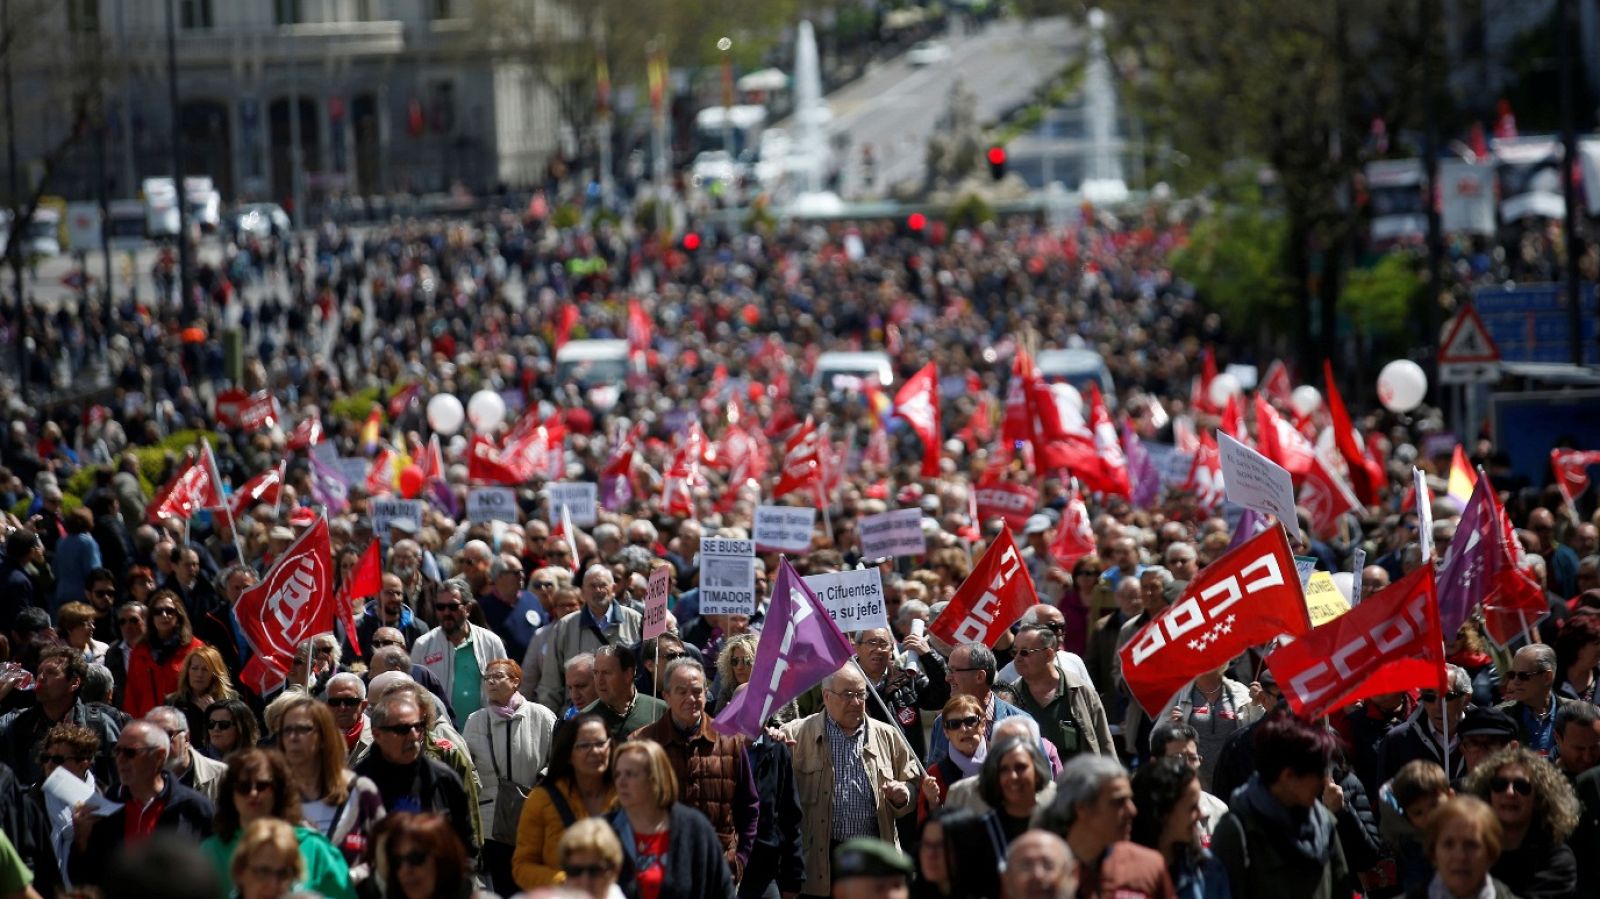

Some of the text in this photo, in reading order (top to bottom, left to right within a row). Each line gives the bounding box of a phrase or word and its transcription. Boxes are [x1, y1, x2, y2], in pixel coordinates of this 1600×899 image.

[478, 492, 505, 506] NO
[703, 541, 752, 553] SE BUSCA
[702, 590, 752, 603] TIMADOR
[827, 583, 880, 601] Cifuentes,
[704, 604, 753, 615] en serie.
[840, 606, 854, 619] su
[856, 600, 882, 620] jefe!
